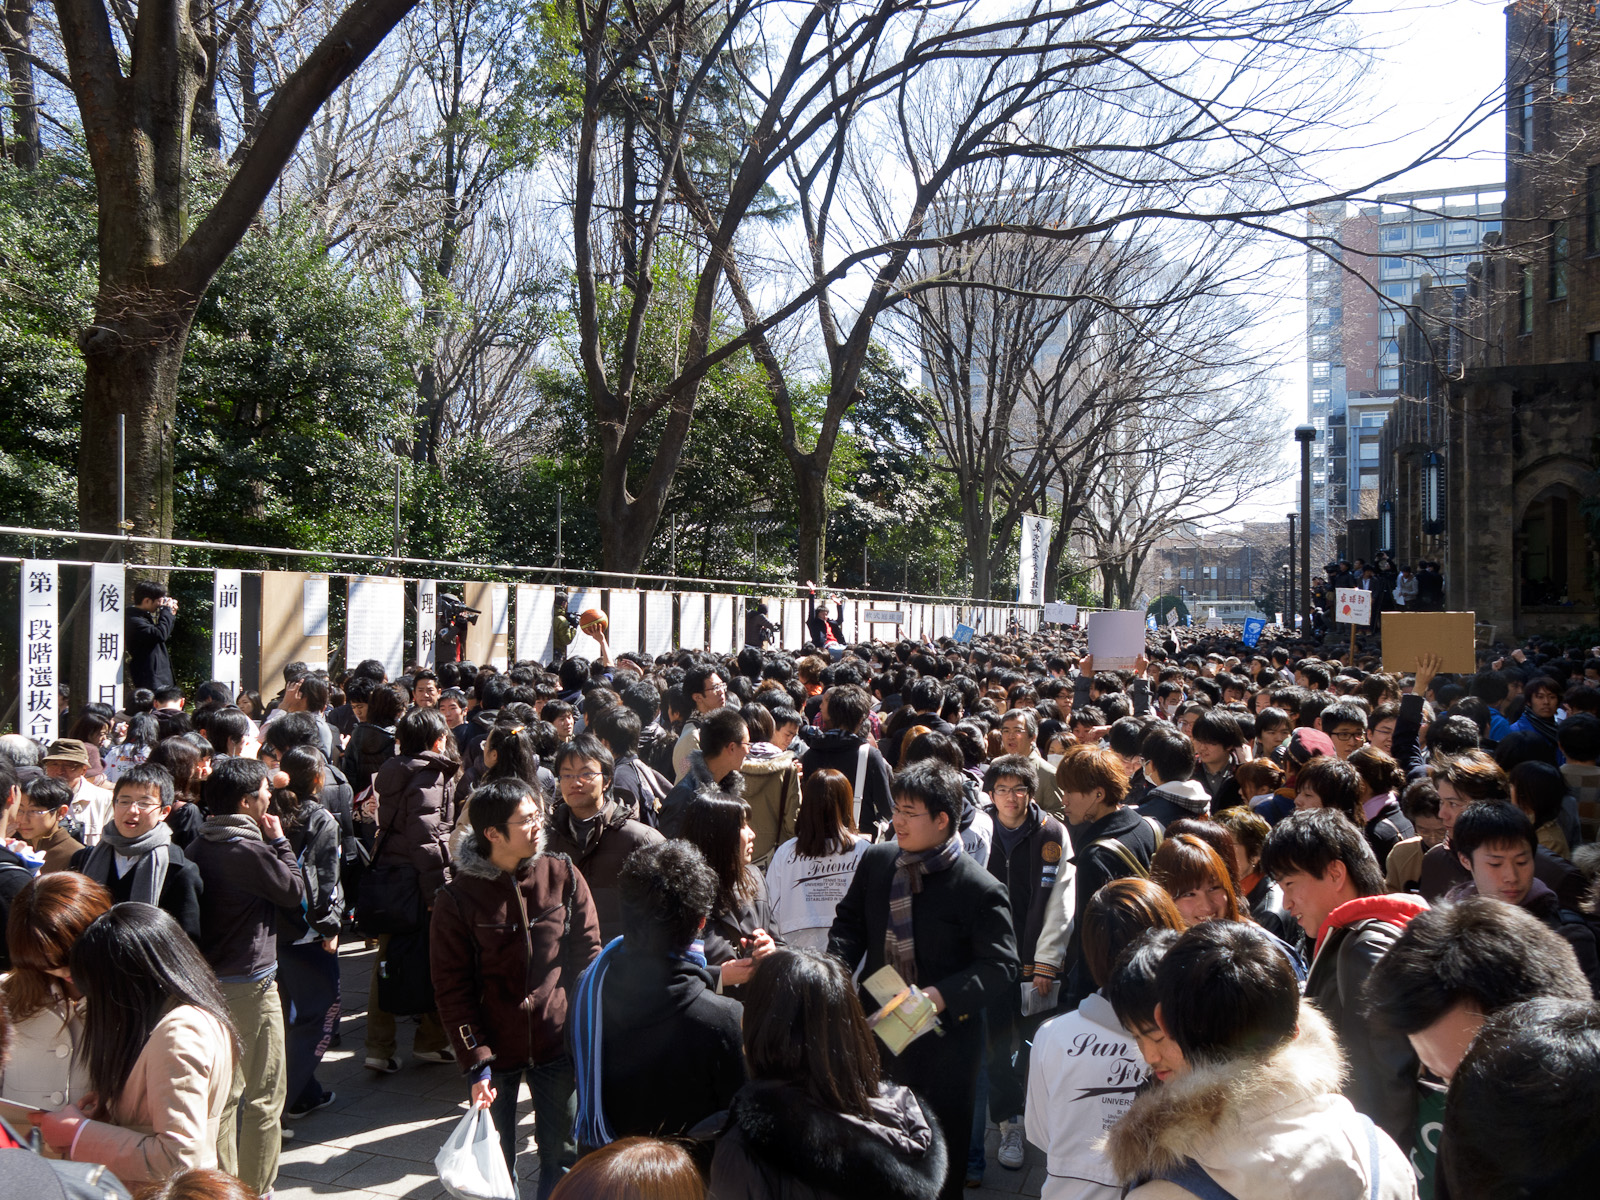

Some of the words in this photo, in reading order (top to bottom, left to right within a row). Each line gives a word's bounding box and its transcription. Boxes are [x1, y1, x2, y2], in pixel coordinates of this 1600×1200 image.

[421, 593, 435, 651] 理科
[808, 855, 858, 877] Friend
[323, 1002, 341, 1033] TENNIS
[314, 1034, 331, 1056] CLUB
[1067, 1033, 1128, 1057] Sun
